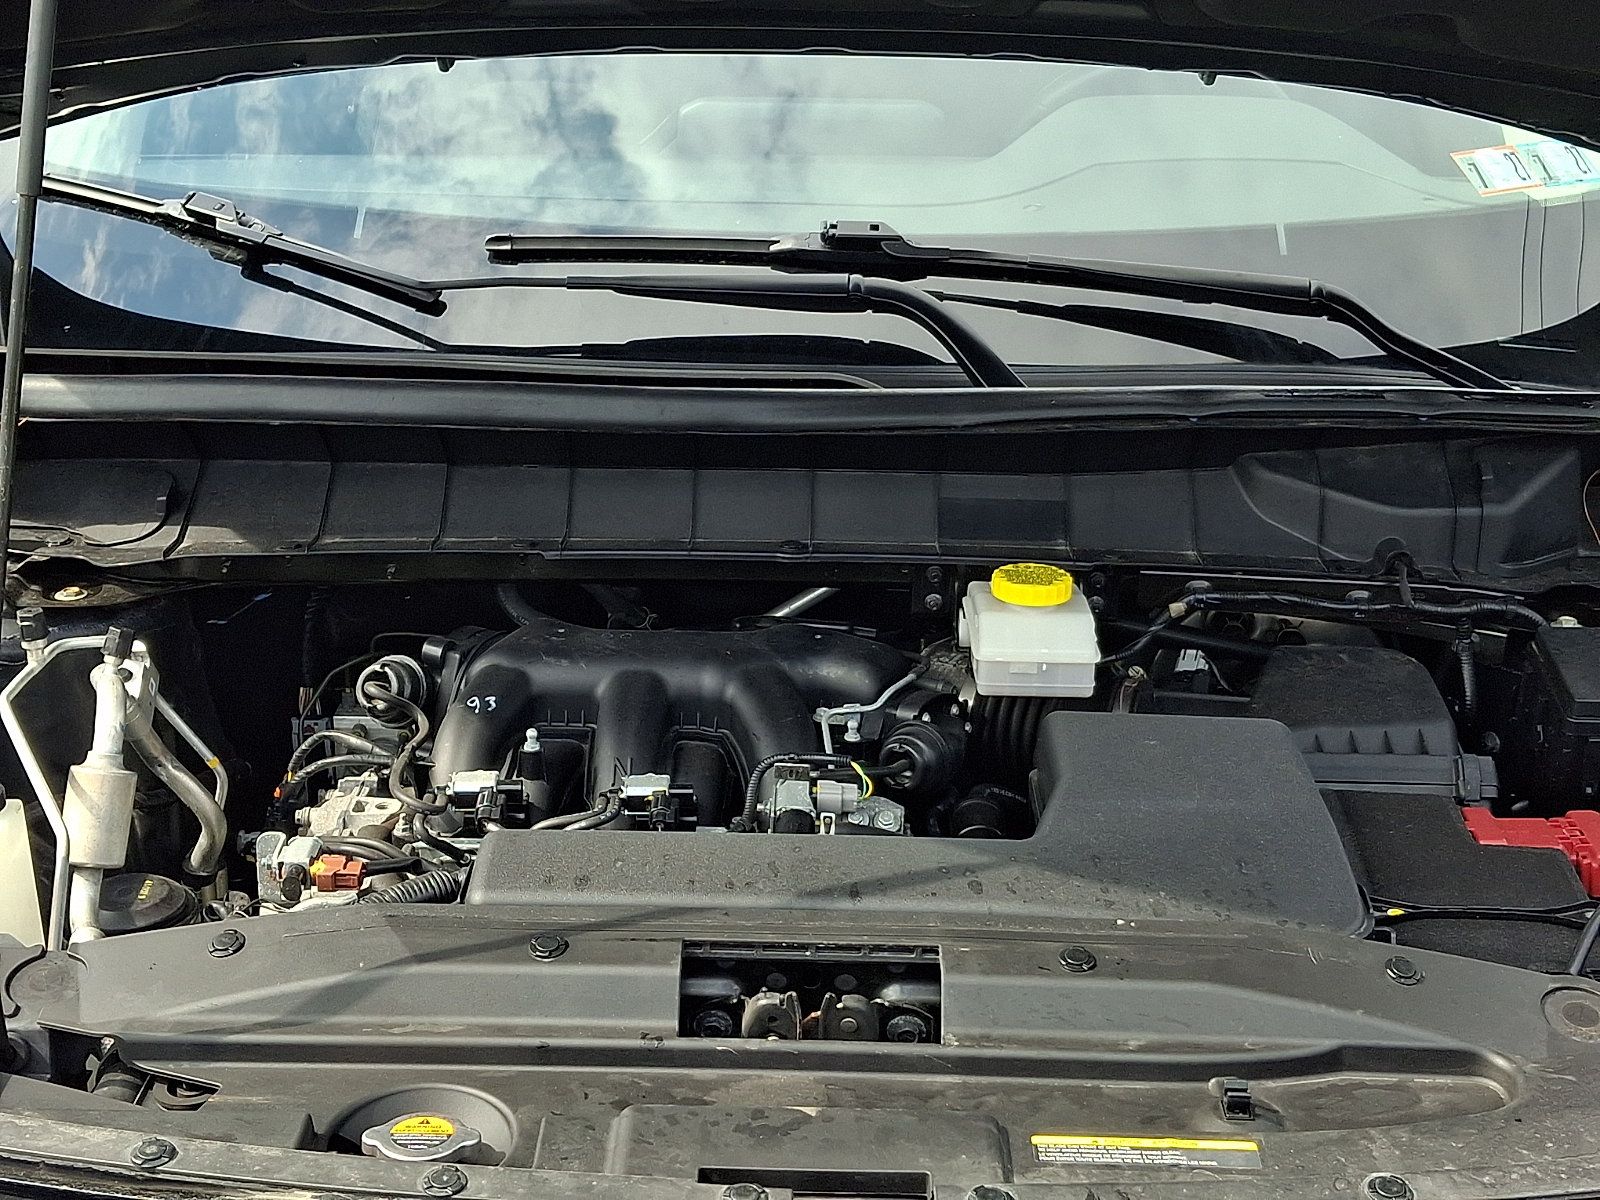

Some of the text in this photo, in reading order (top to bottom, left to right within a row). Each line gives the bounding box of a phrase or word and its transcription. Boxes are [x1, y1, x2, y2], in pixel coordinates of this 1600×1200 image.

[1503, 151, 1532, 181] 27
[1564, 145, 1592, 174] 27
[466, 695, 497, 714] 93
